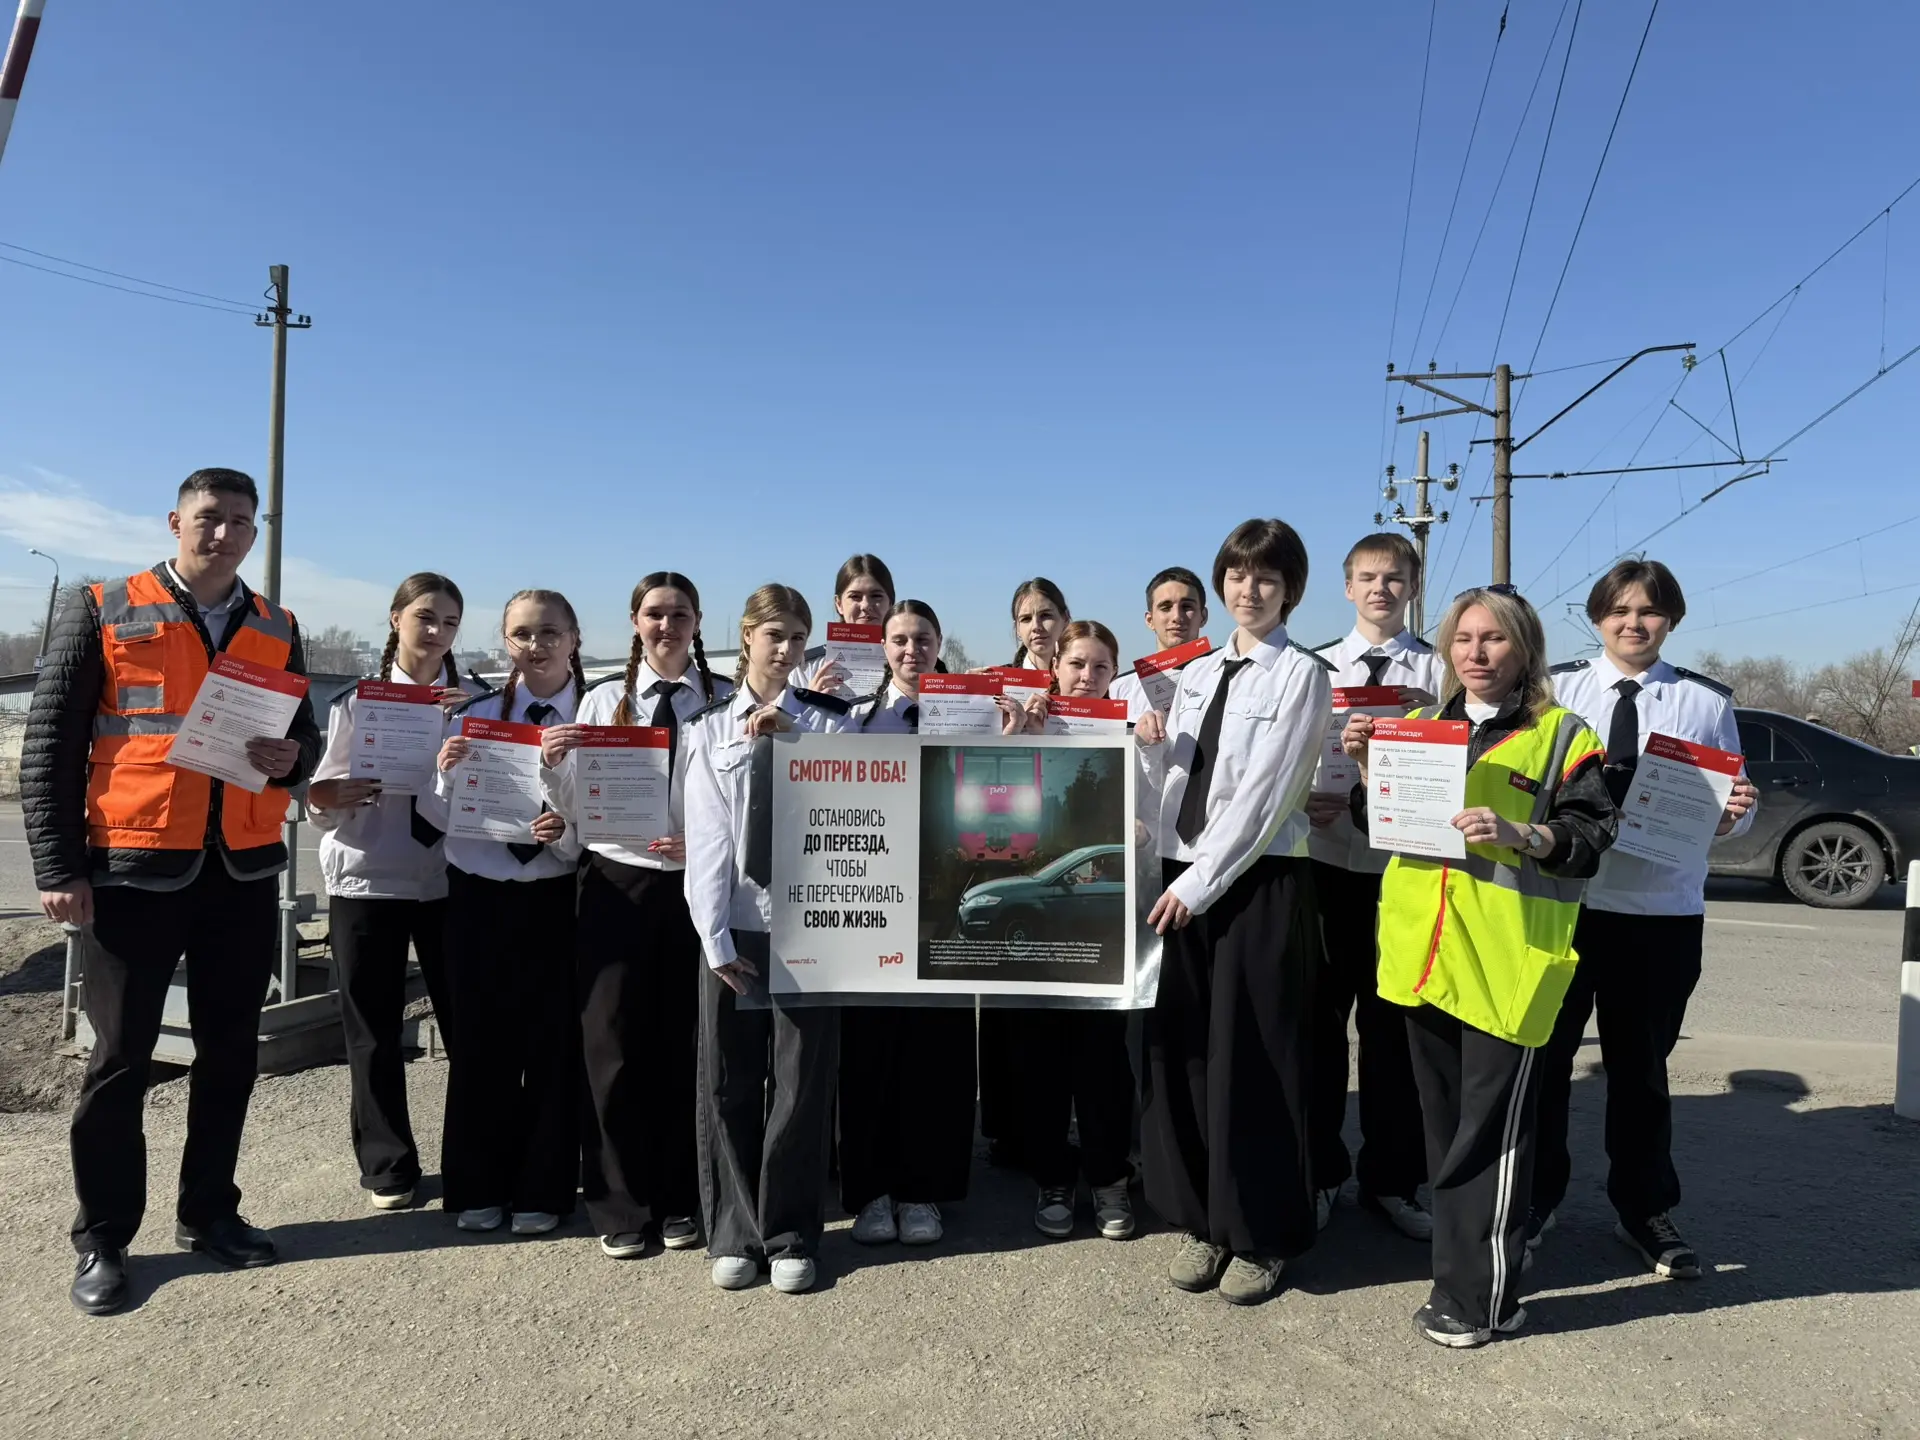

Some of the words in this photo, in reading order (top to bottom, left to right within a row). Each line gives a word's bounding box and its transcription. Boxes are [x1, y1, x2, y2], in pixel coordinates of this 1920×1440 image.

[789, 759, 852, 783] СМОТРИ
[857, 760, 867, 783] В
[870, 760, 907, 783] ОБА!
[809, 808, 885, 827] ОСТАНОВИСЬ
[803, 834, 821, 855] ДО
[824, 834, 890, 855] ПЕРЕЕЗДА,
[826, 859, 867, 878] ЧТОБЫ
[788, 884, 804, 903] НЕ
[807, 884, 904, 903] ПЕРЕЧЕРКИВАТЬ
[804, 910, 840, 929] СВОЮ
[842, 910, 887, 929] ЖИЗНЬ
